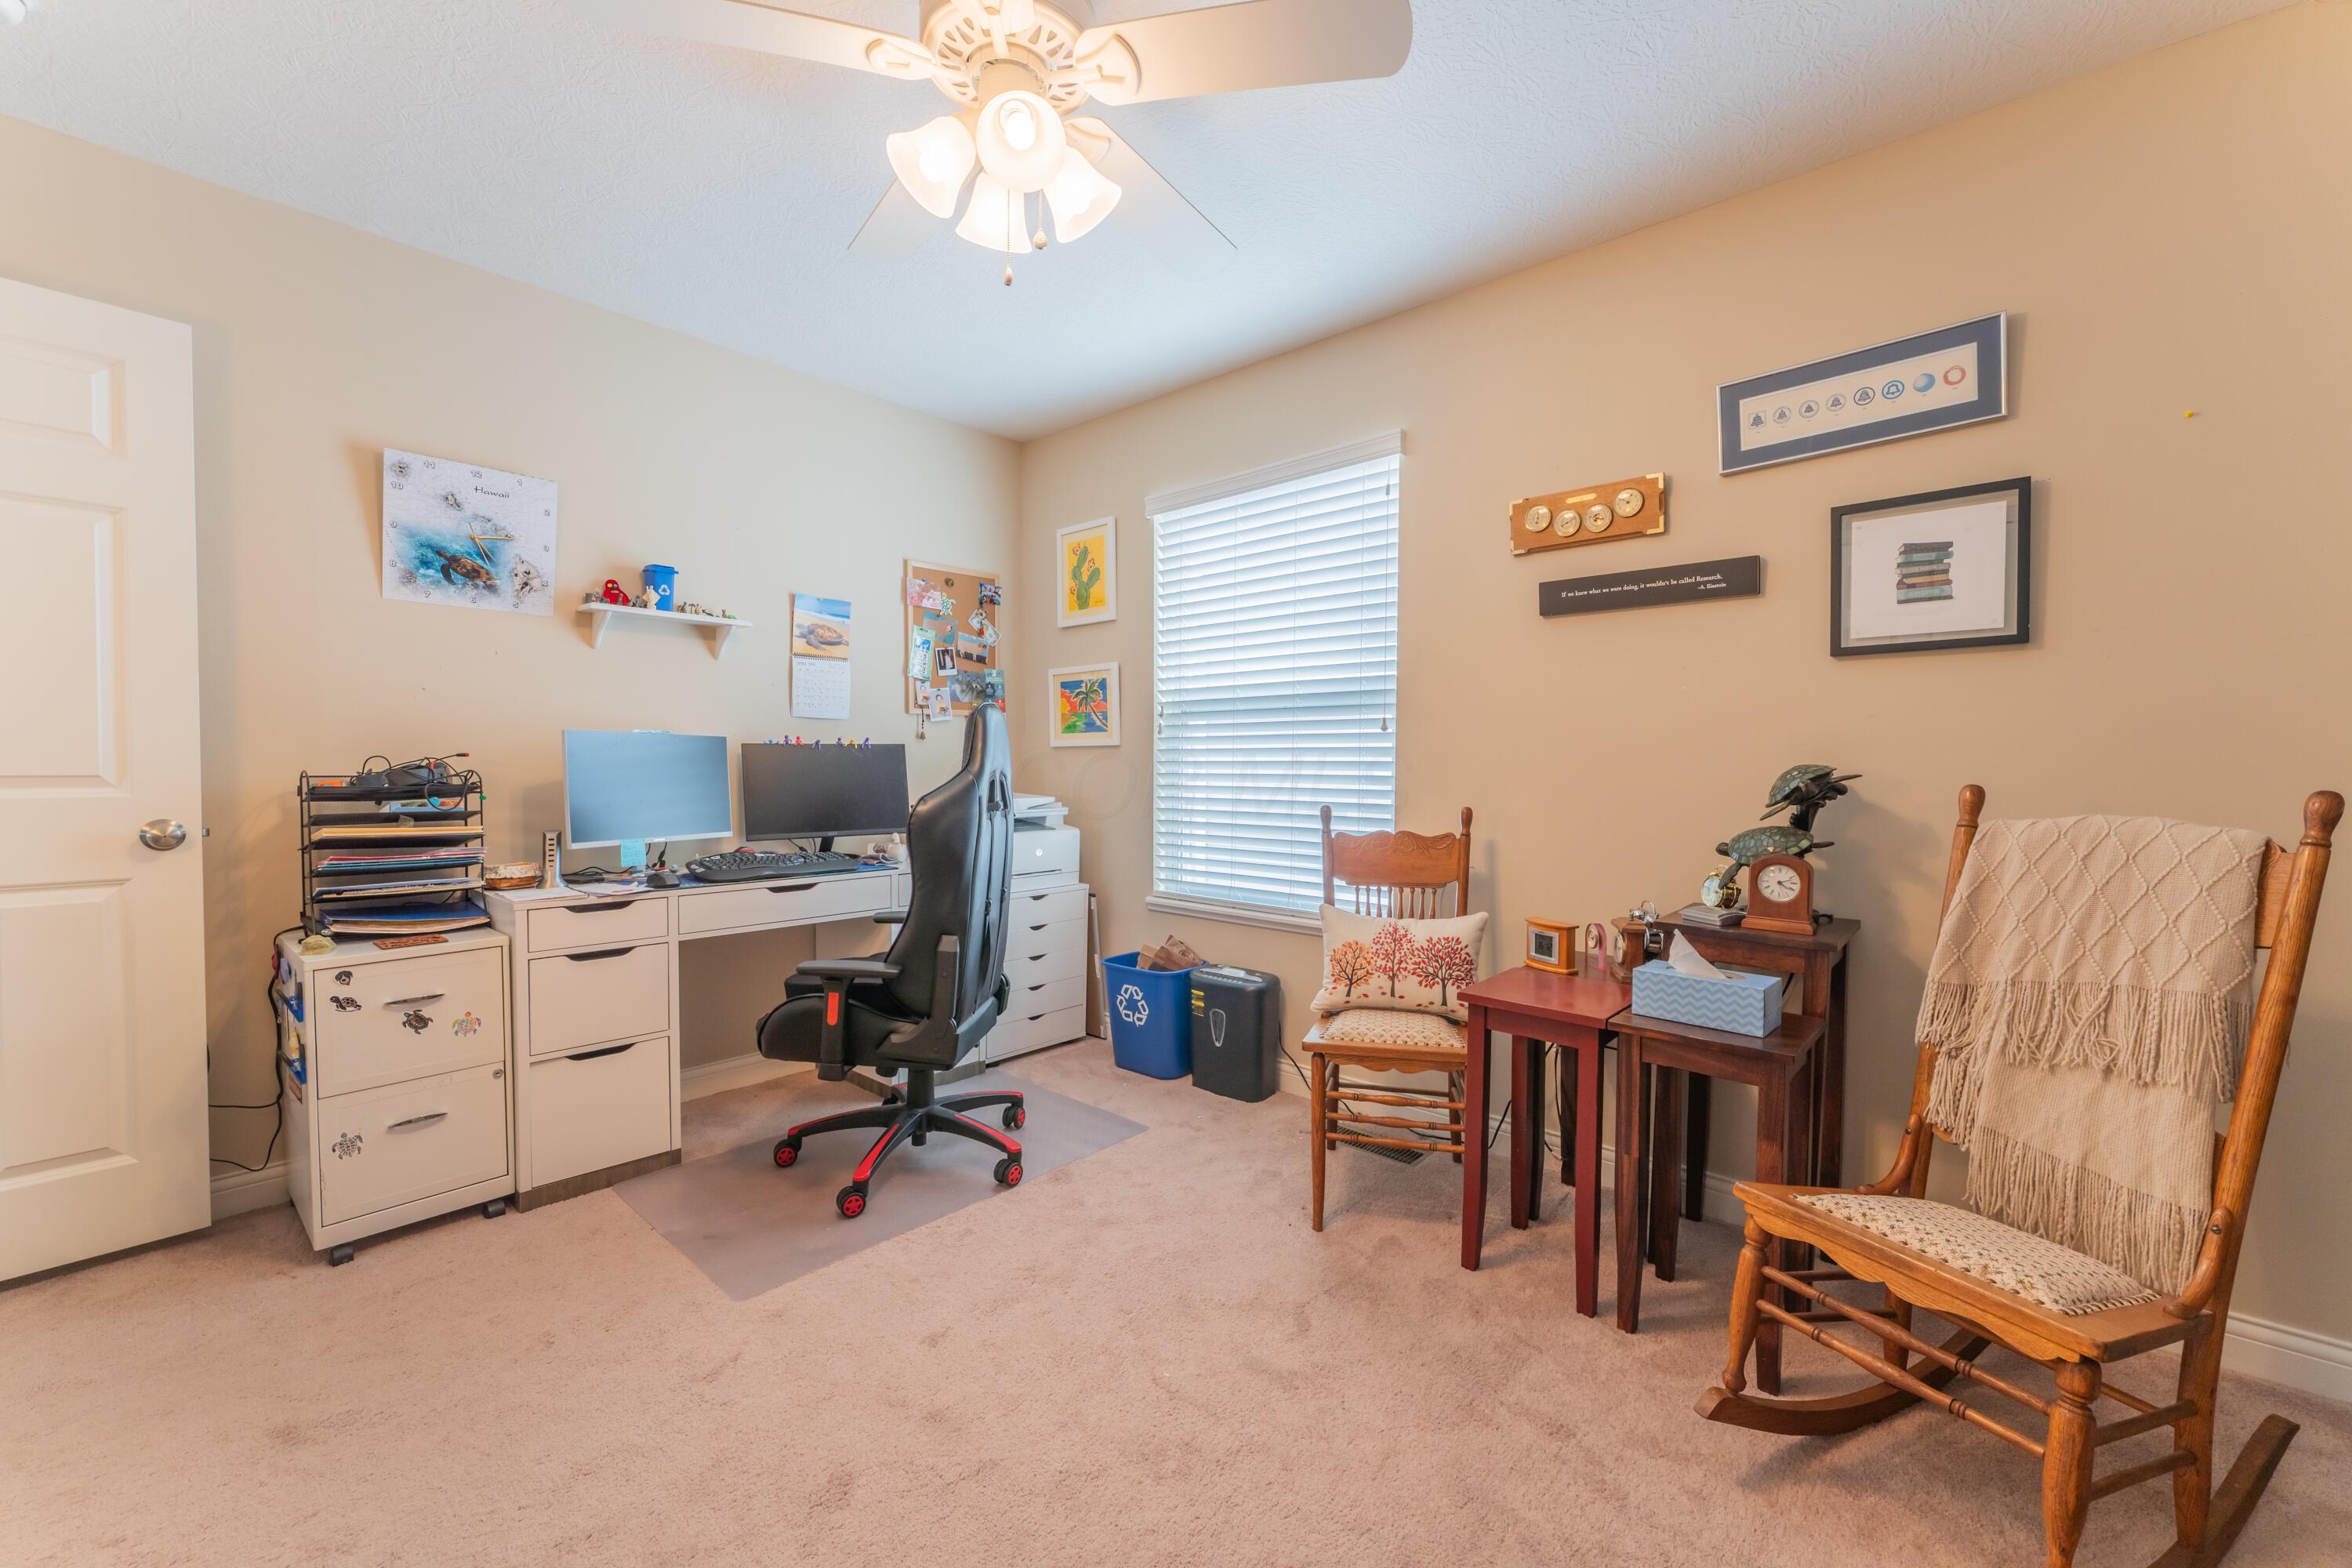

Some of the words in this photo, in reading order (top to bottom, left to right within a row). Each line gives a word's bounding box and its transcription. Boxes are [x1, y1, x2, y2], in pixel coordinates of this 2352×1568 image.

[424, 460, 434, 469] 11
[470, 470, 482, 478] 12
[390, 481, 404, 490] 10
[474, 485, 510, 499] Hawaii
[1646, 579, 1670, 588] wouldn't
[1678, 575, 1695, 584] called
[1696, 573, 1723, 583] Research.
